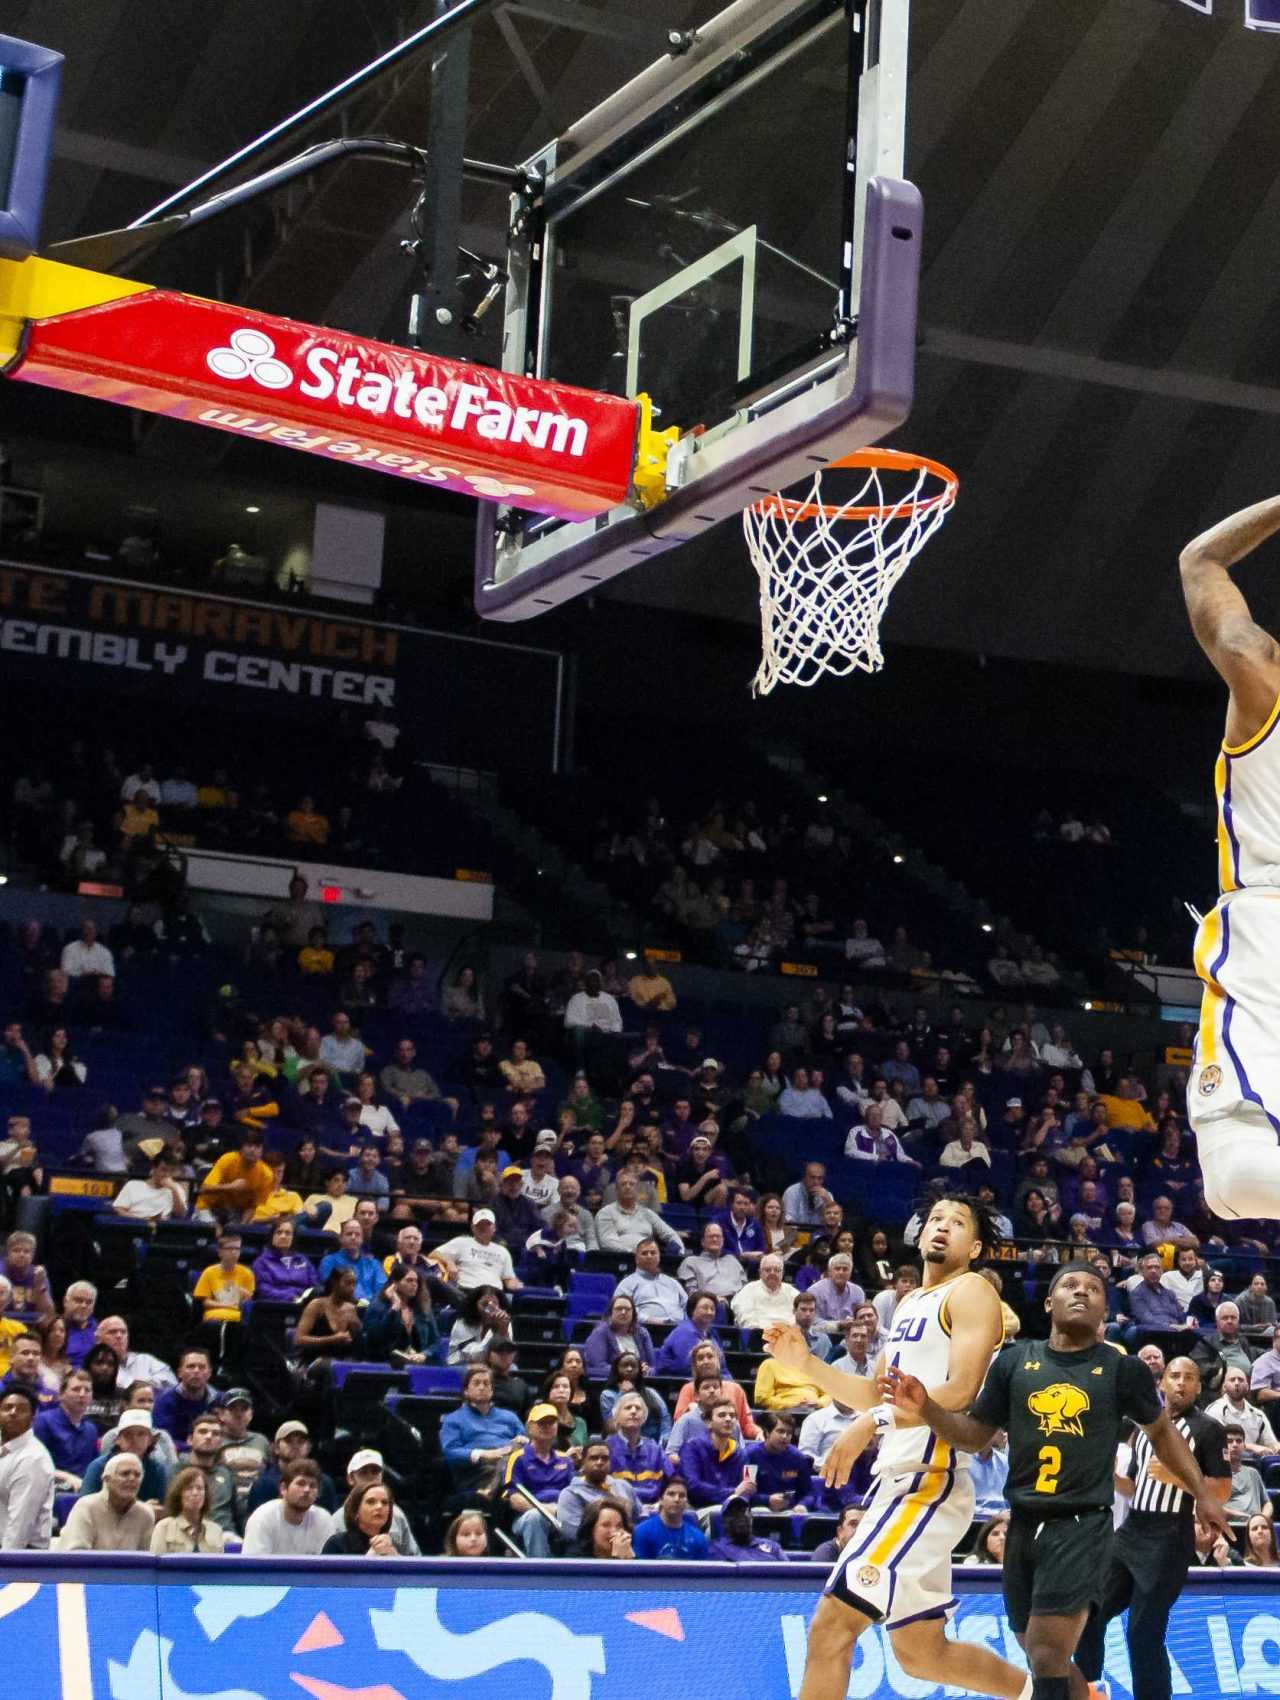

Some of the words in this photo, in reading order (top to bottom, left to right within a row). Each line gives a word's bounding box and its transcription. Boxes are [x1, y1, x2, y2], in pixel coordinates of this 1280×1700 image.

[88, 585, 398, 666] MARAVICH
[203, 651, 395, 706] CENTER
[886, 1317, 928, 1342] SU
[1035, 1445, 1062, 1493] 2
